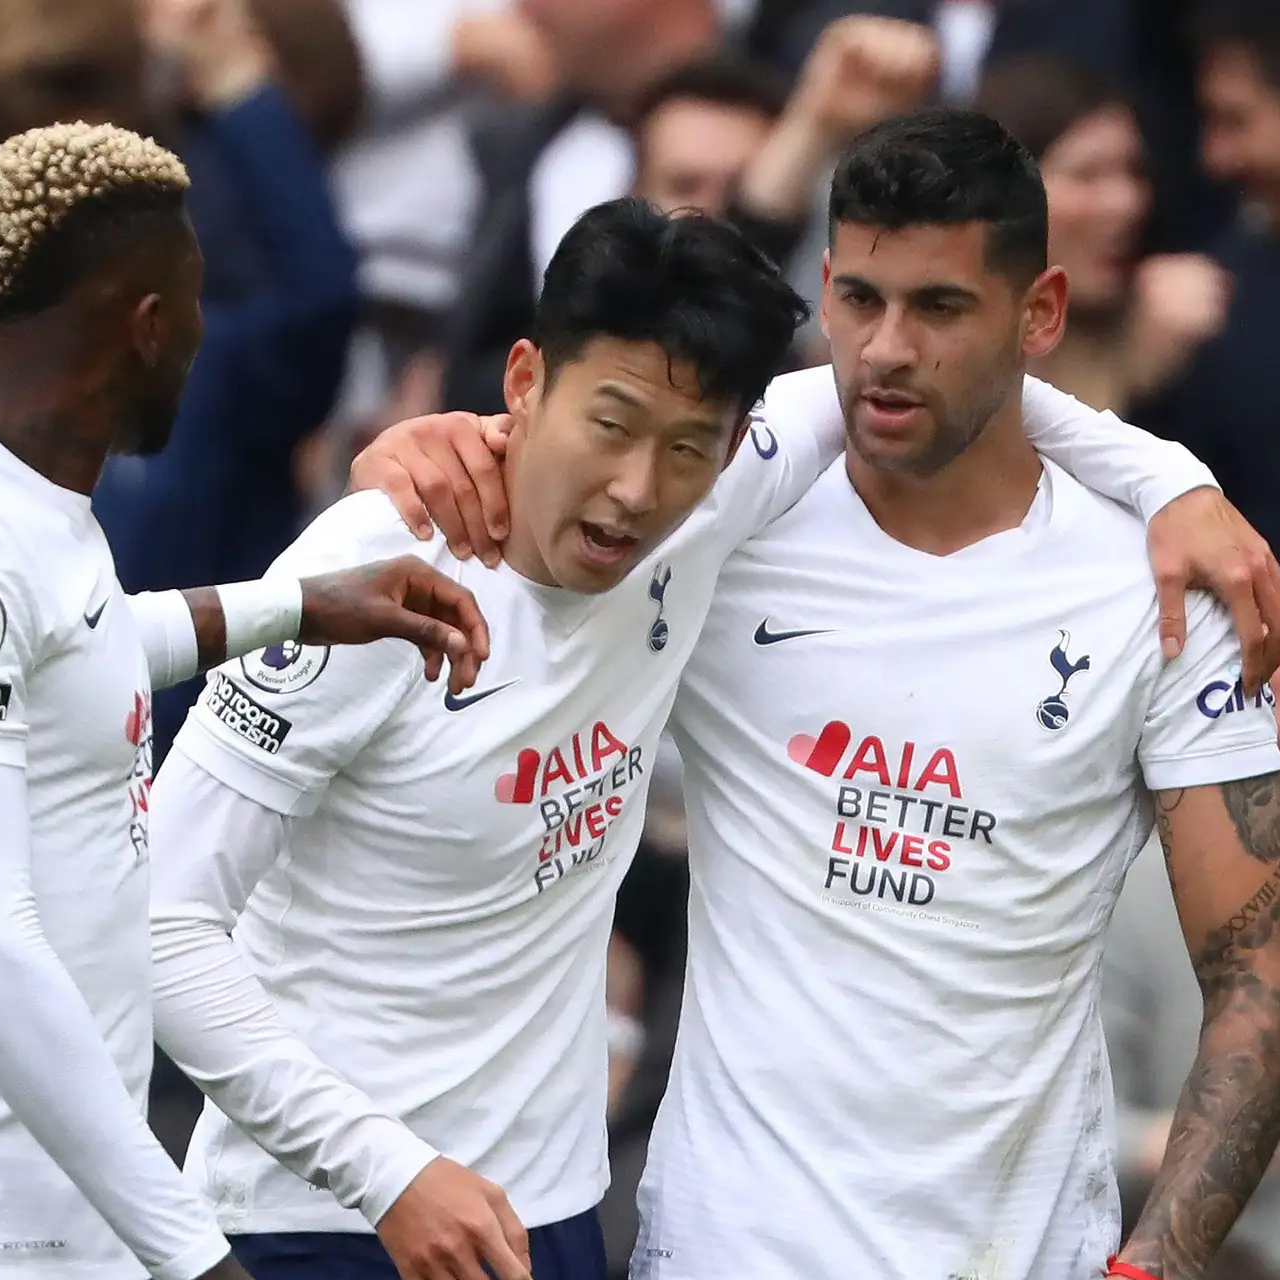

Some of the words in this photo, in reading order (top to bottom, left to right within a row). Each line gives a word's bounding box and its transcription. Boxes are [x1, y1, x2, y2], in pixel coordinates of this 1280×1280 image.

[257, 670, 287, 684] Premier
[288, 658, 313, 682] League
[213, 674, 234, 700] No
[230, 692, 280, 735] room
[219, 710, 280, 754] racism
[541, 721, 629, 796] AIA
[842, 735, 963, 799] AIA
[837, 786, 997, 844] BETTER
[831, 821, 952, 871] LIVES
[824, 857, 936, 905] FUND
[831, 898, 862, 911] support
[863, 901, 872, 910] of
[872, 903, 917, 919] Community
